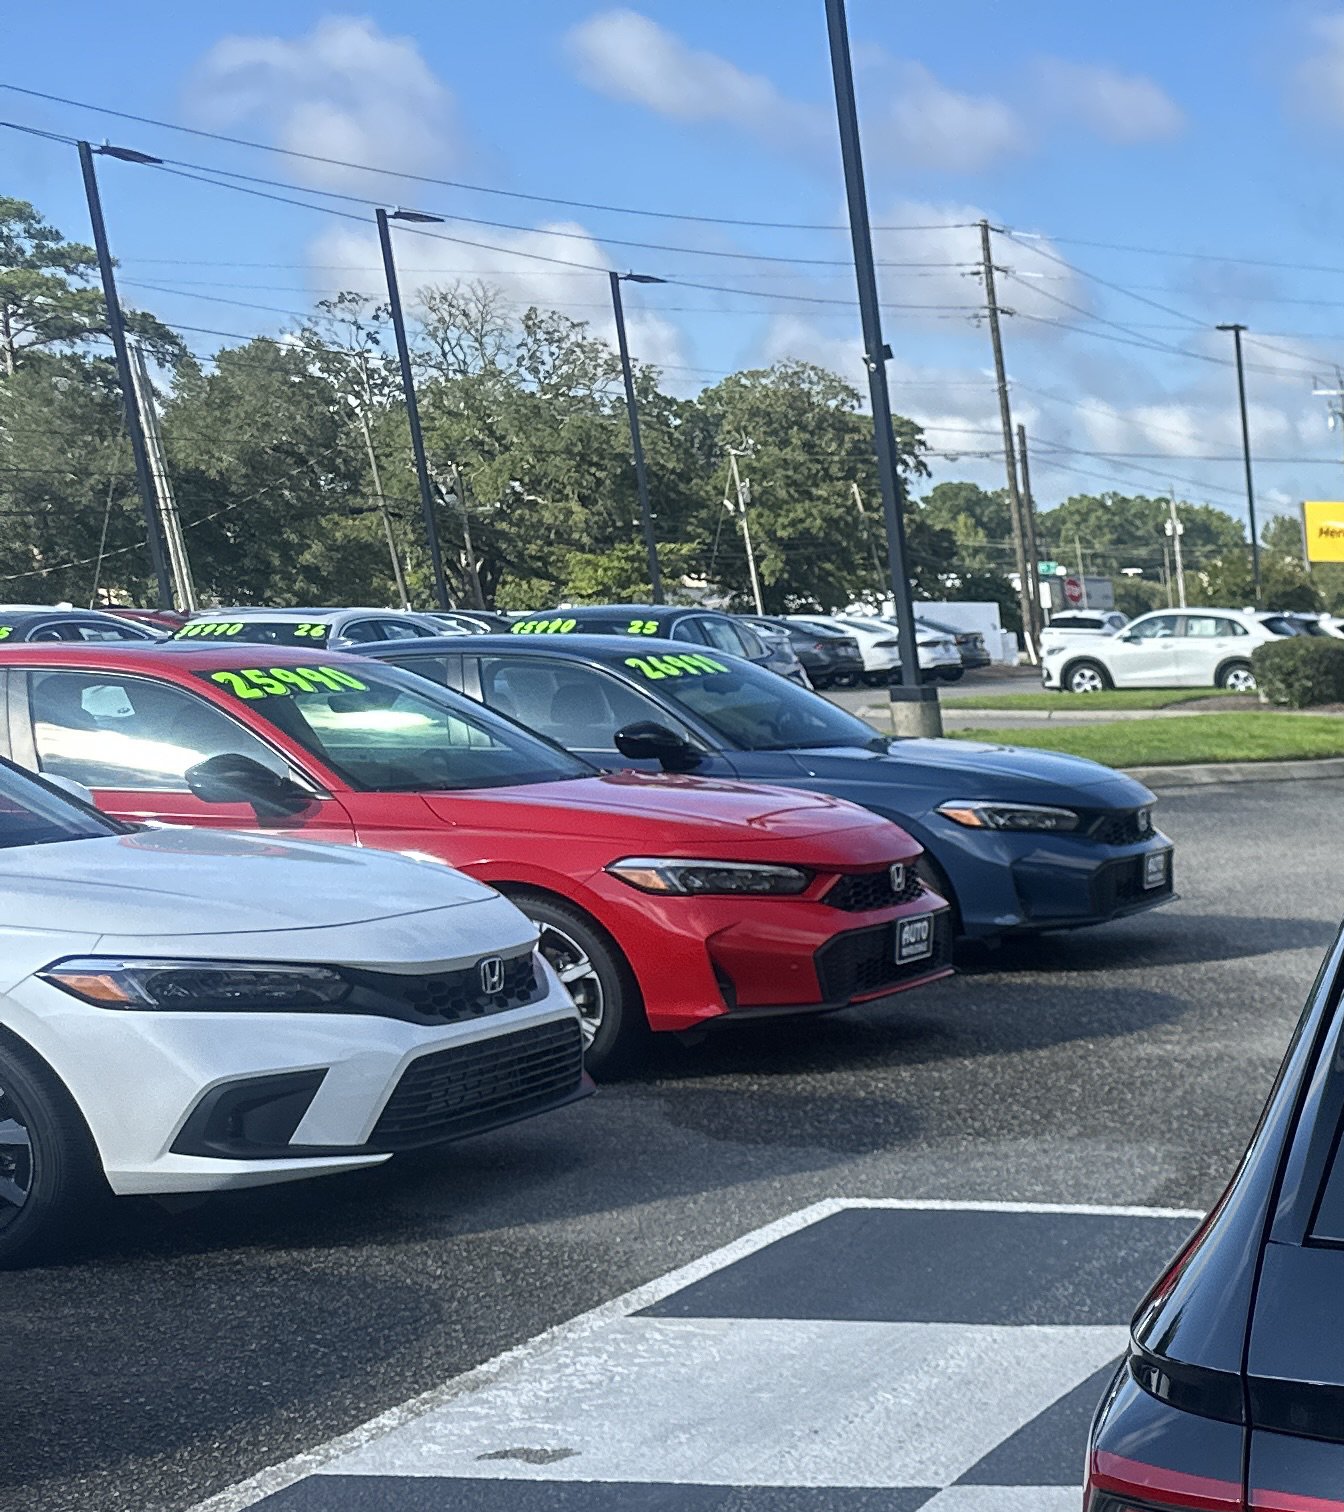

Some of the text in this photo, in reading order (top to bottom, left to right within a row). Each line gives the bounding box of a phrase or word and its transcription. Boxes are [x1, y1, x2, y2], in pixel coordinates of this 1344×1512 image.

[292, 625, 327, 638] 26
[627, 621, 659, 635] 25
[211, 666, 371, 699] 25990
